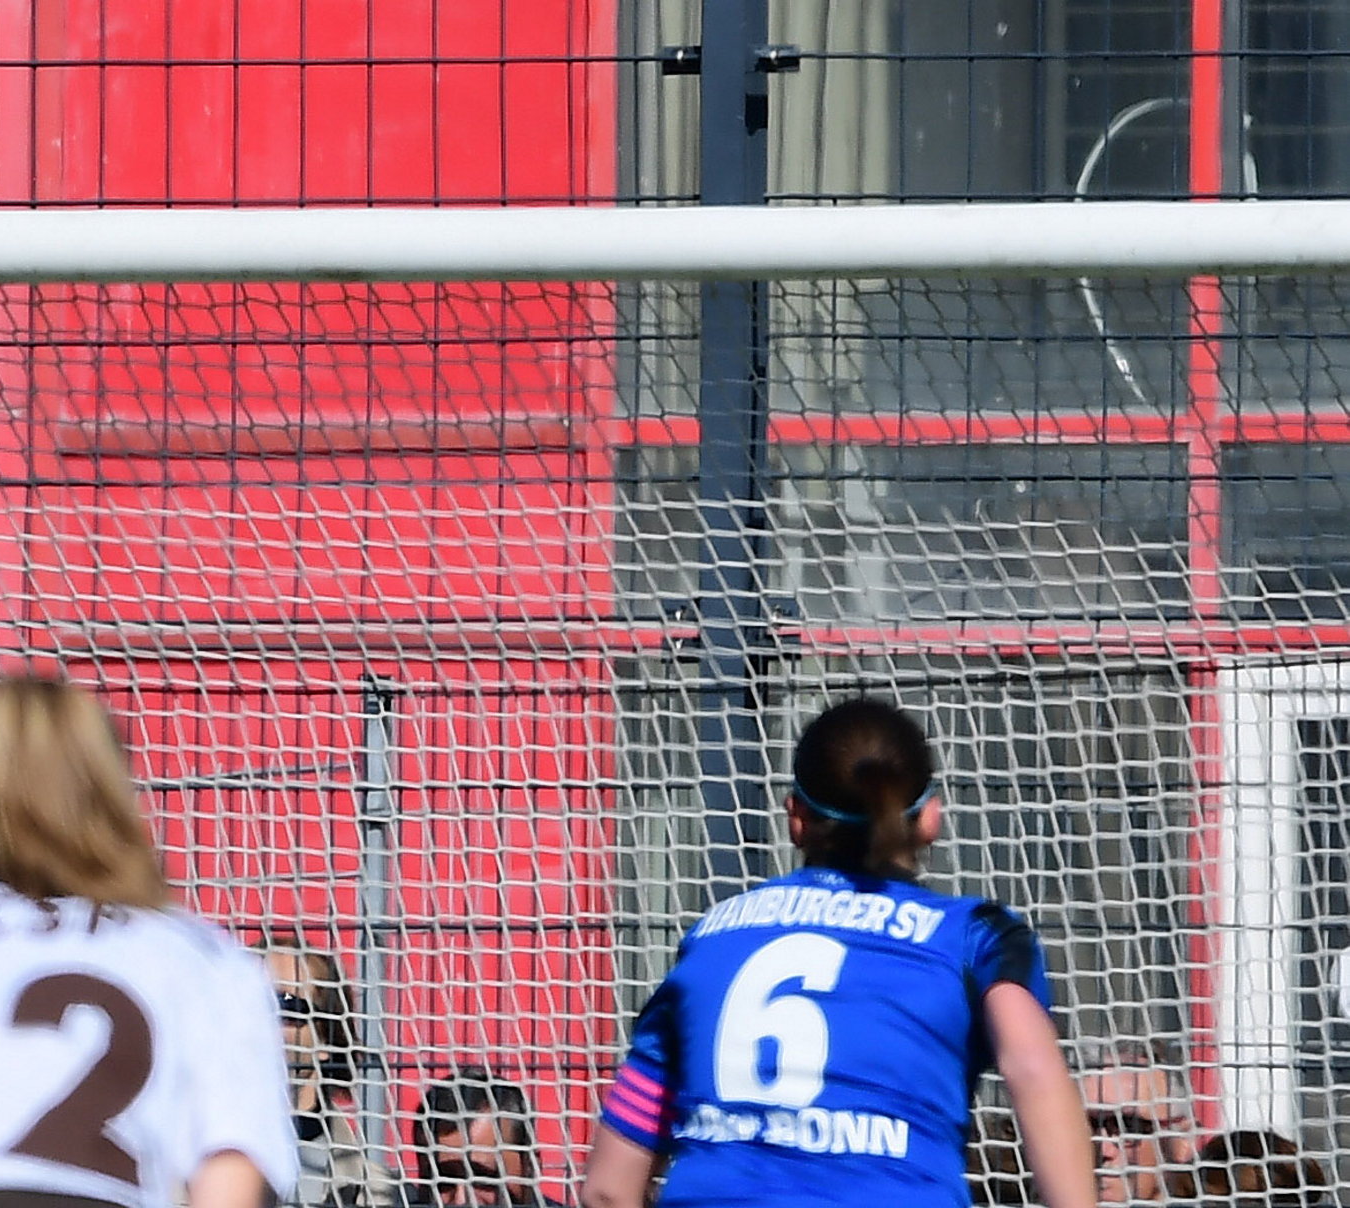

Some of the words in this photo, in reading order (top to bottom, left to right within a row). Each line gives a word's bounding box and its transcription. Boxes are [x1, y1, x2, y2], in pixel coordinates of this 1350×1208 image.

[693, 884, 895, 939] HAMBURGER
[887, 899, 946, 944] SV
[714, 931, 848, 1108] 6
